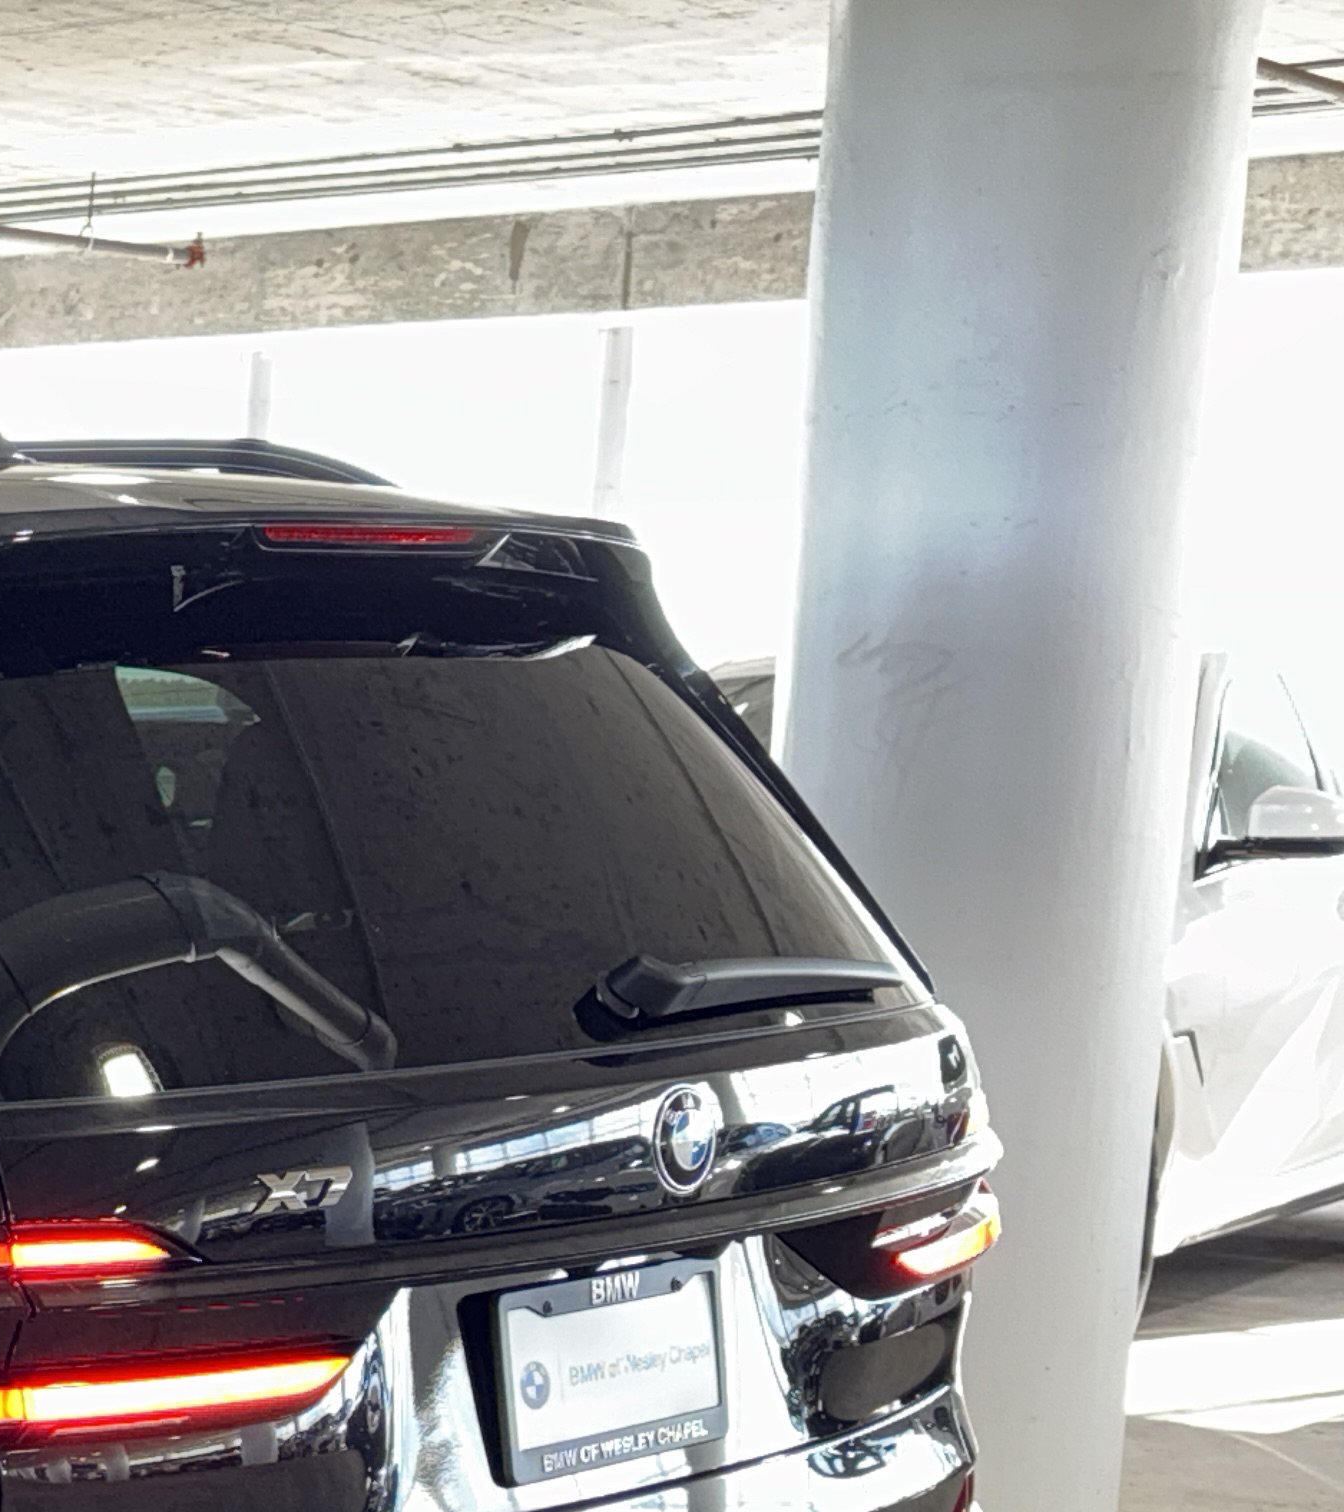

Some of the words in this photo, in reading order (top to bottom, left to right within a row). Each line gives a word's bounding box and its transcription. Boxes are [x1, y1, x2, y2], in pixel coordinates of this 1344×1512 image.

[252, 1165, 353, 1214] X7
[591, 1270, 640, 1305] BMW
[569, 1361, 605, 1386] BMW
[608, 1358, 622, 1378] of
[542, 1447, 578, 1473] BMW
[579, 1441, 599, 1463] OF
[599, 1430, 655, 1459] WESLEY
[657, 1419, 708, 1445] CHAPEL
